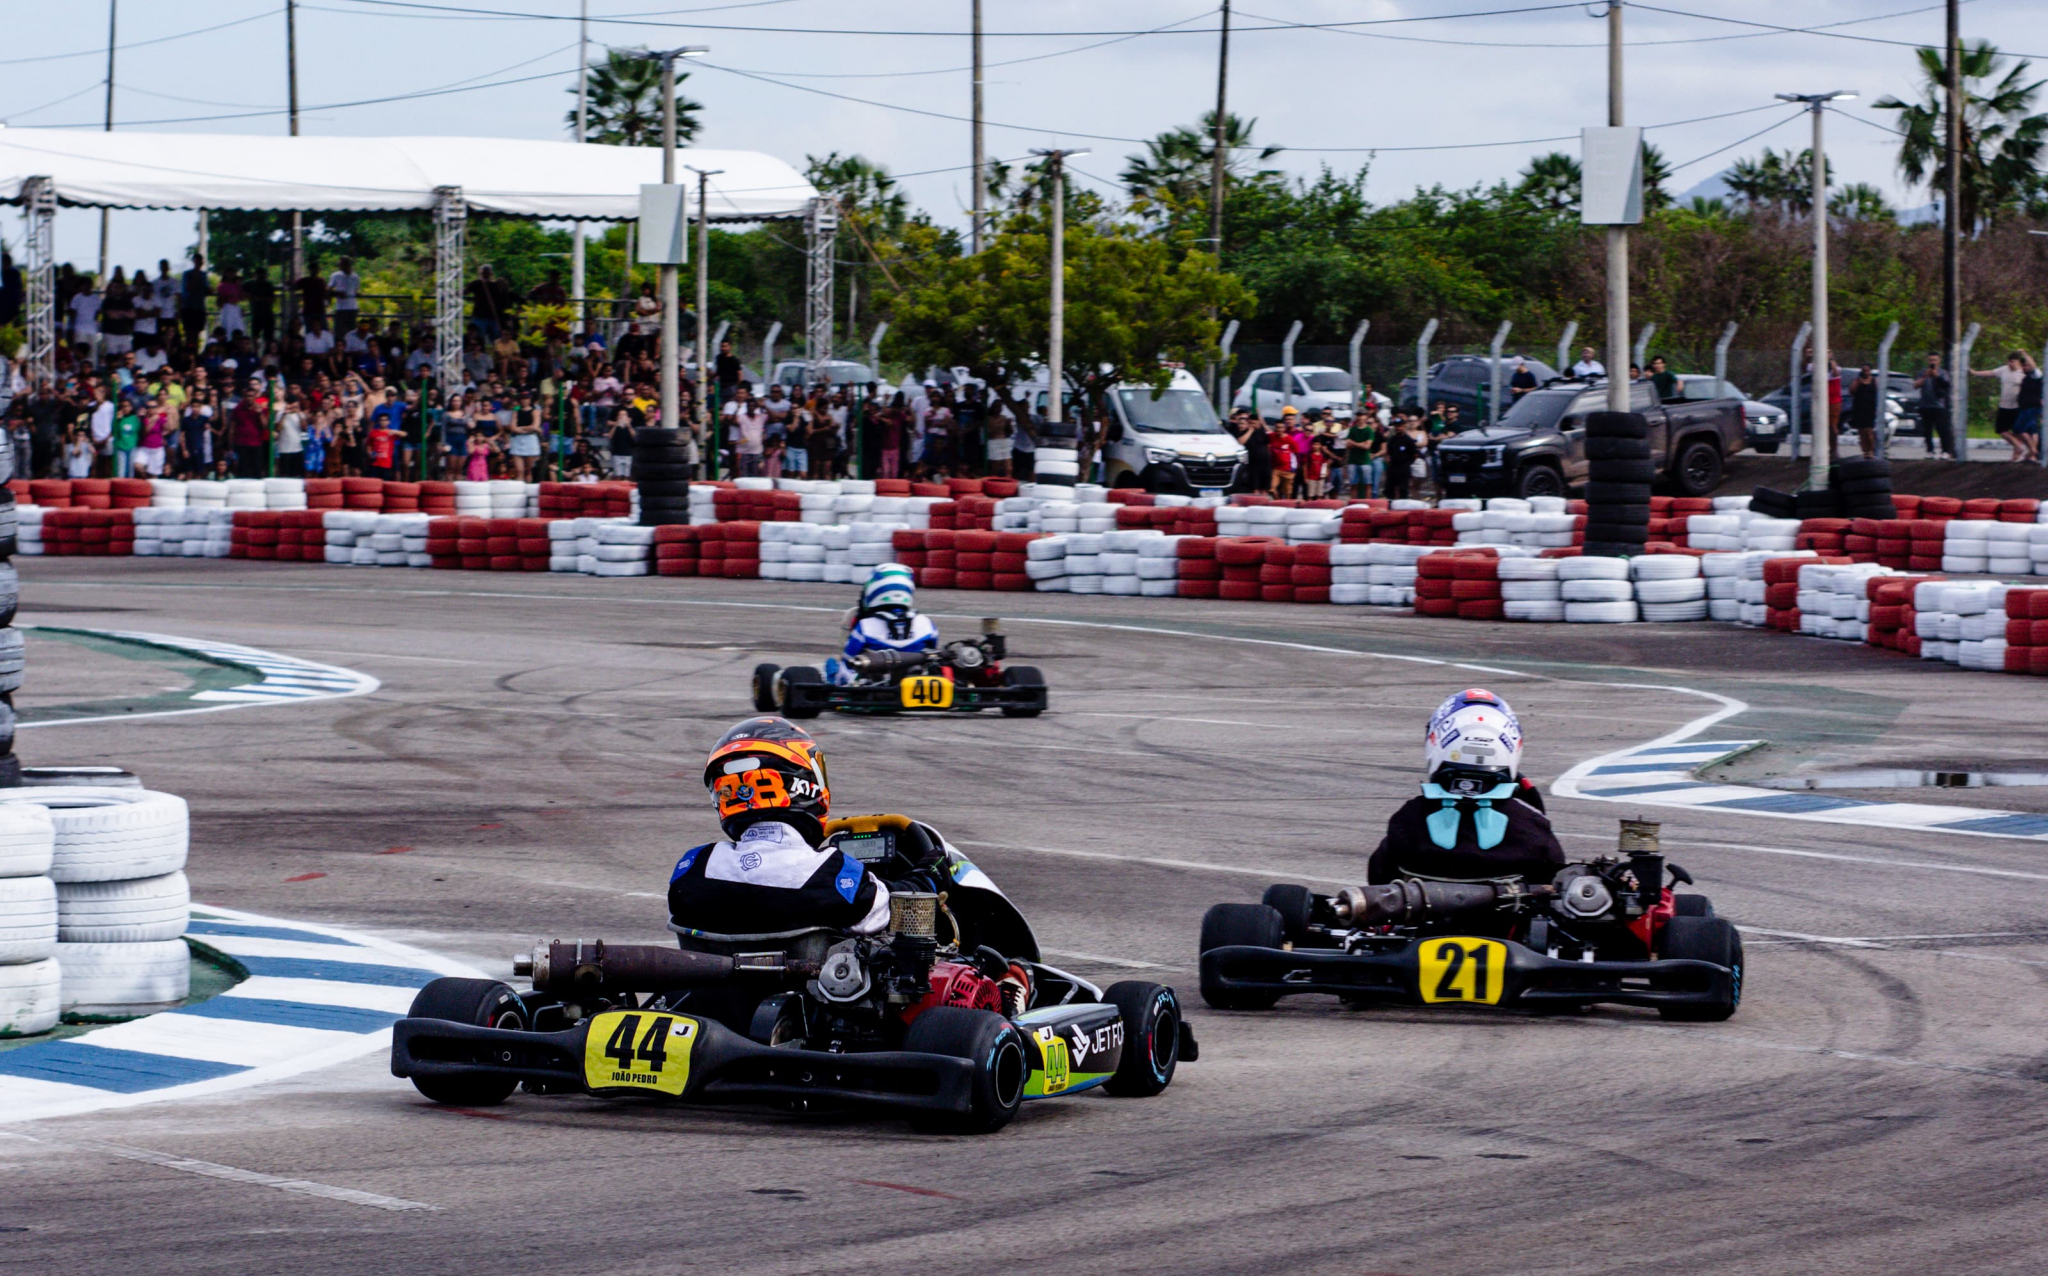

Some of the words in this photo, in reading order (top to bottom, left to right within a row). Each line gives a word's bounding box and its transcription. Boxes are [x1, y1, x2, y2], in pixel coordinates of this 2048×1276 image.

[912, 680, 942, 704] 40
[714, 768, 791, 820] 28
[790, 777, 820, 798] KYT
[1435, 942, 1489, 1000] 21
[605, 1014, 673, 1072] 44
[675, 1026, 689, 1036] J
[1044, 1028, 1051, 1040] J
[1092, 1026, 1111, 1054] JET
[1112, 1021, 1125, 1049] FO
[612, 1071, 631, 1082] JOÃO
[632, 1073, 657, 1084] PEDRO
[1046, 1043, 1066, 1084] 44
